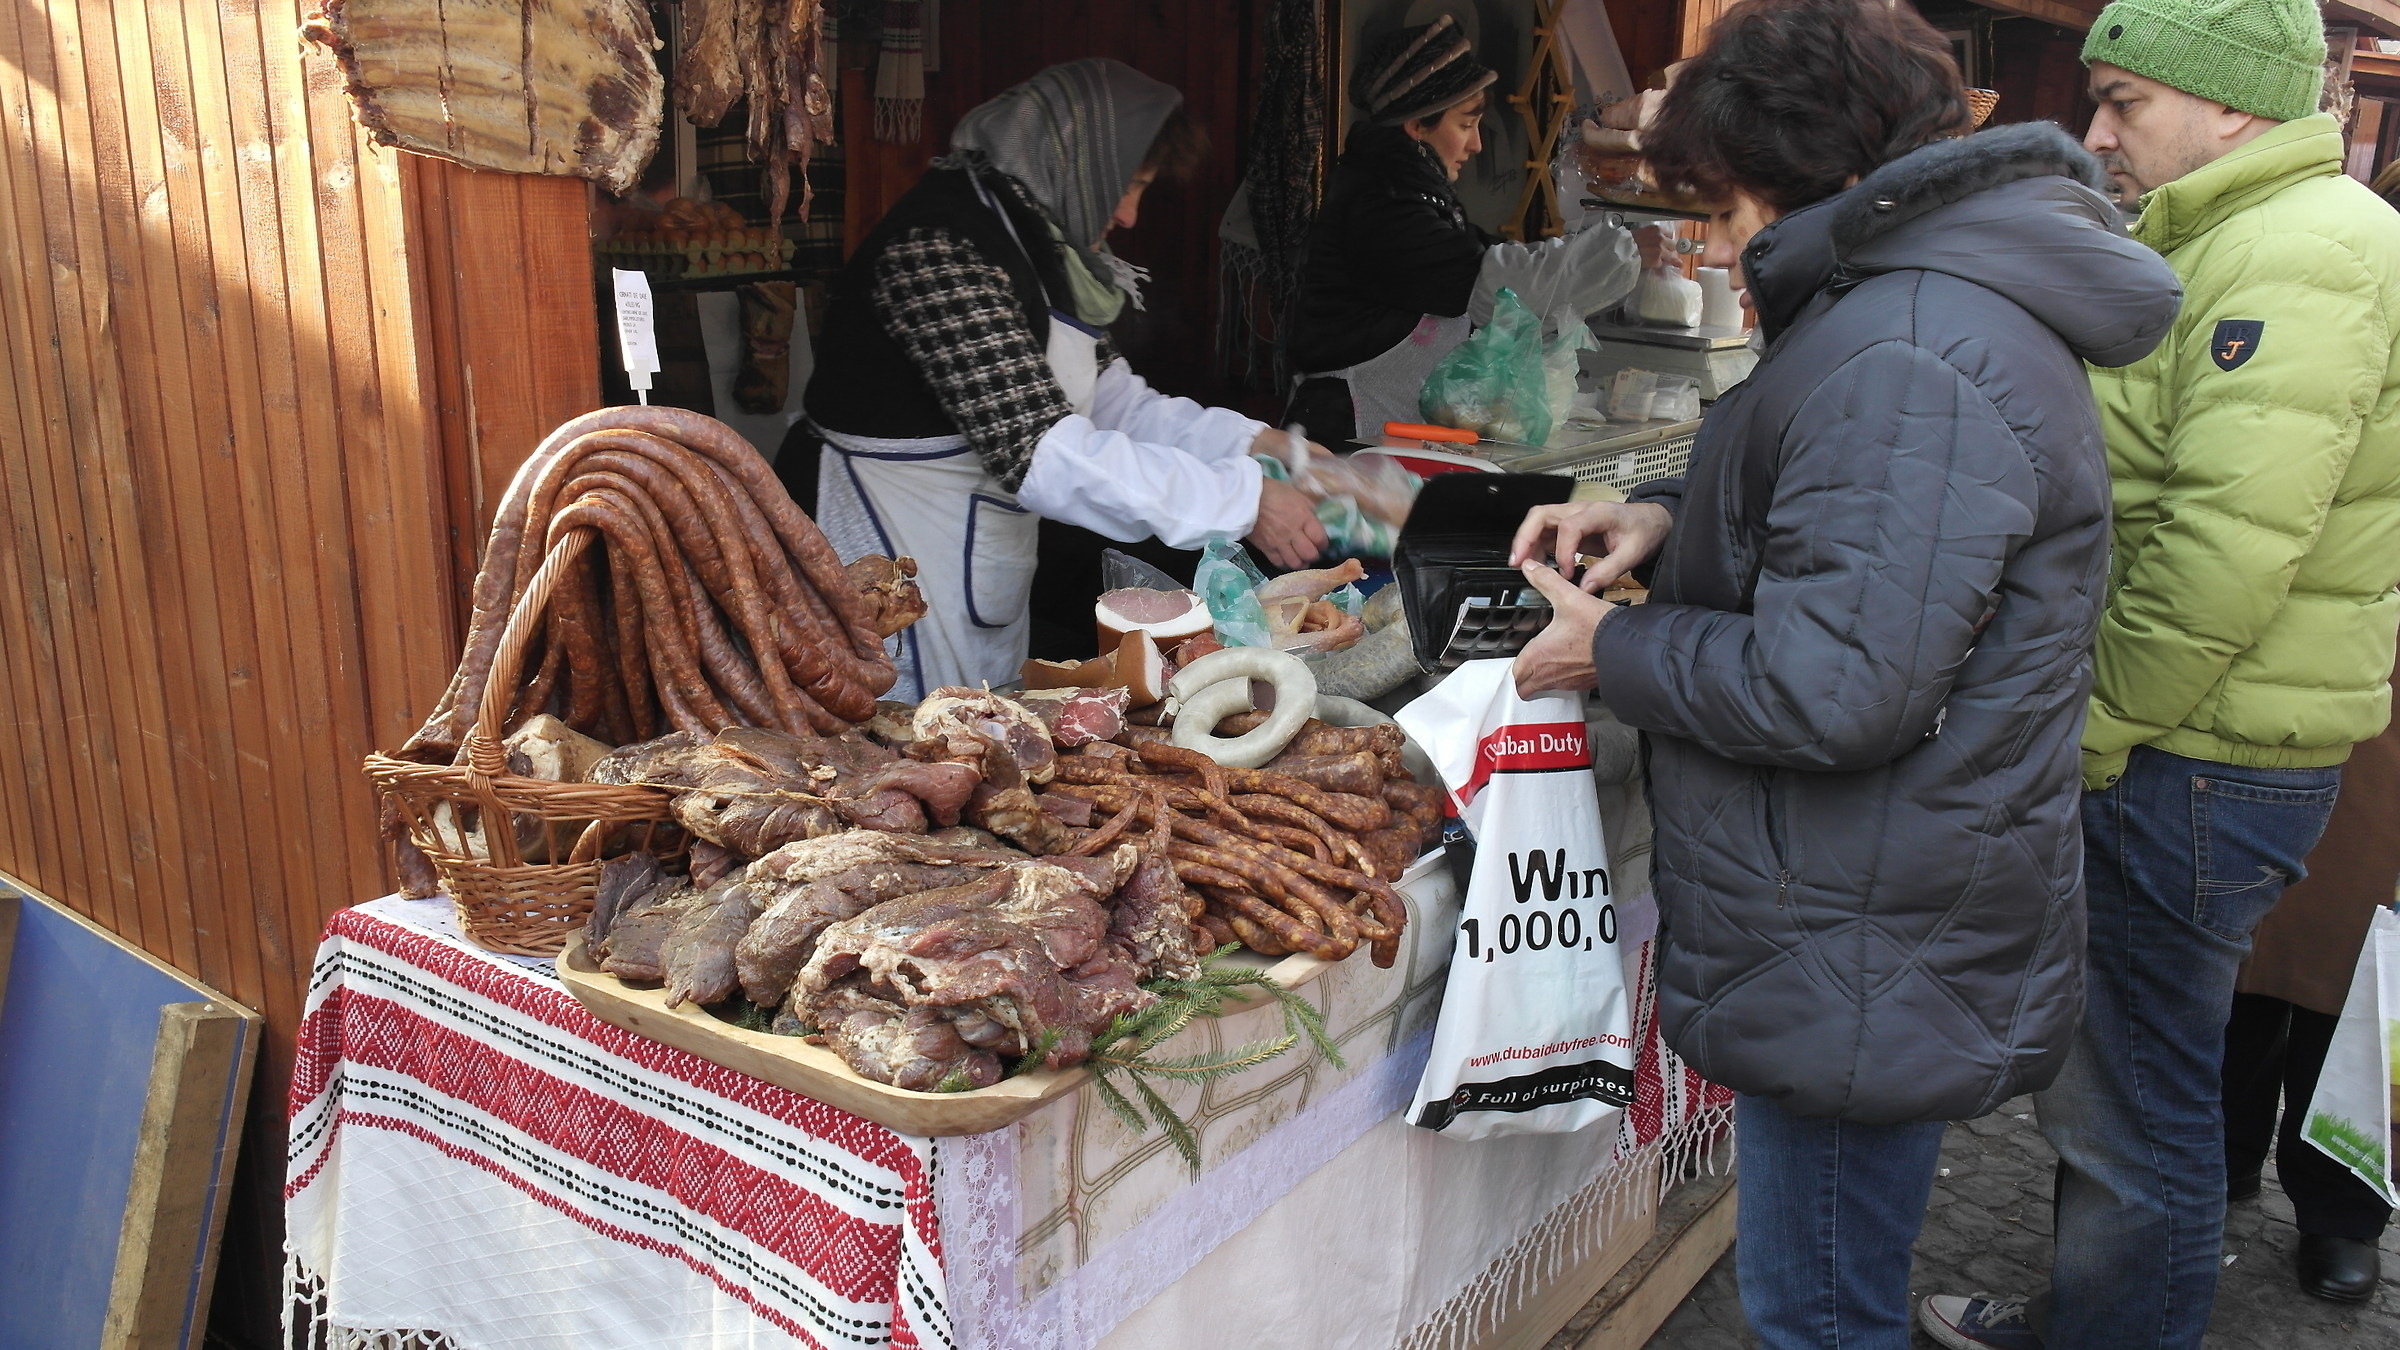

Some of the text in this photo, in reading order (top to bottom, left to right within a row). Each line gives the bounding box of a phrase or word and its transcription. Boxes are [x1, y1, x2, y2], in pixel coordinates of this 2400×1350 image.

[1540, 732, 1583, 757] Duty
[1508, 848, 1609, 904] Win
[1460, 903, 1618, 963] 1,000,0
[1470, 1033, 1631, 1067] www.dubaidutyfree.com
[1478, 1091, 1517, 1104] Full
[1522, 1086, 1539, 1102] of
